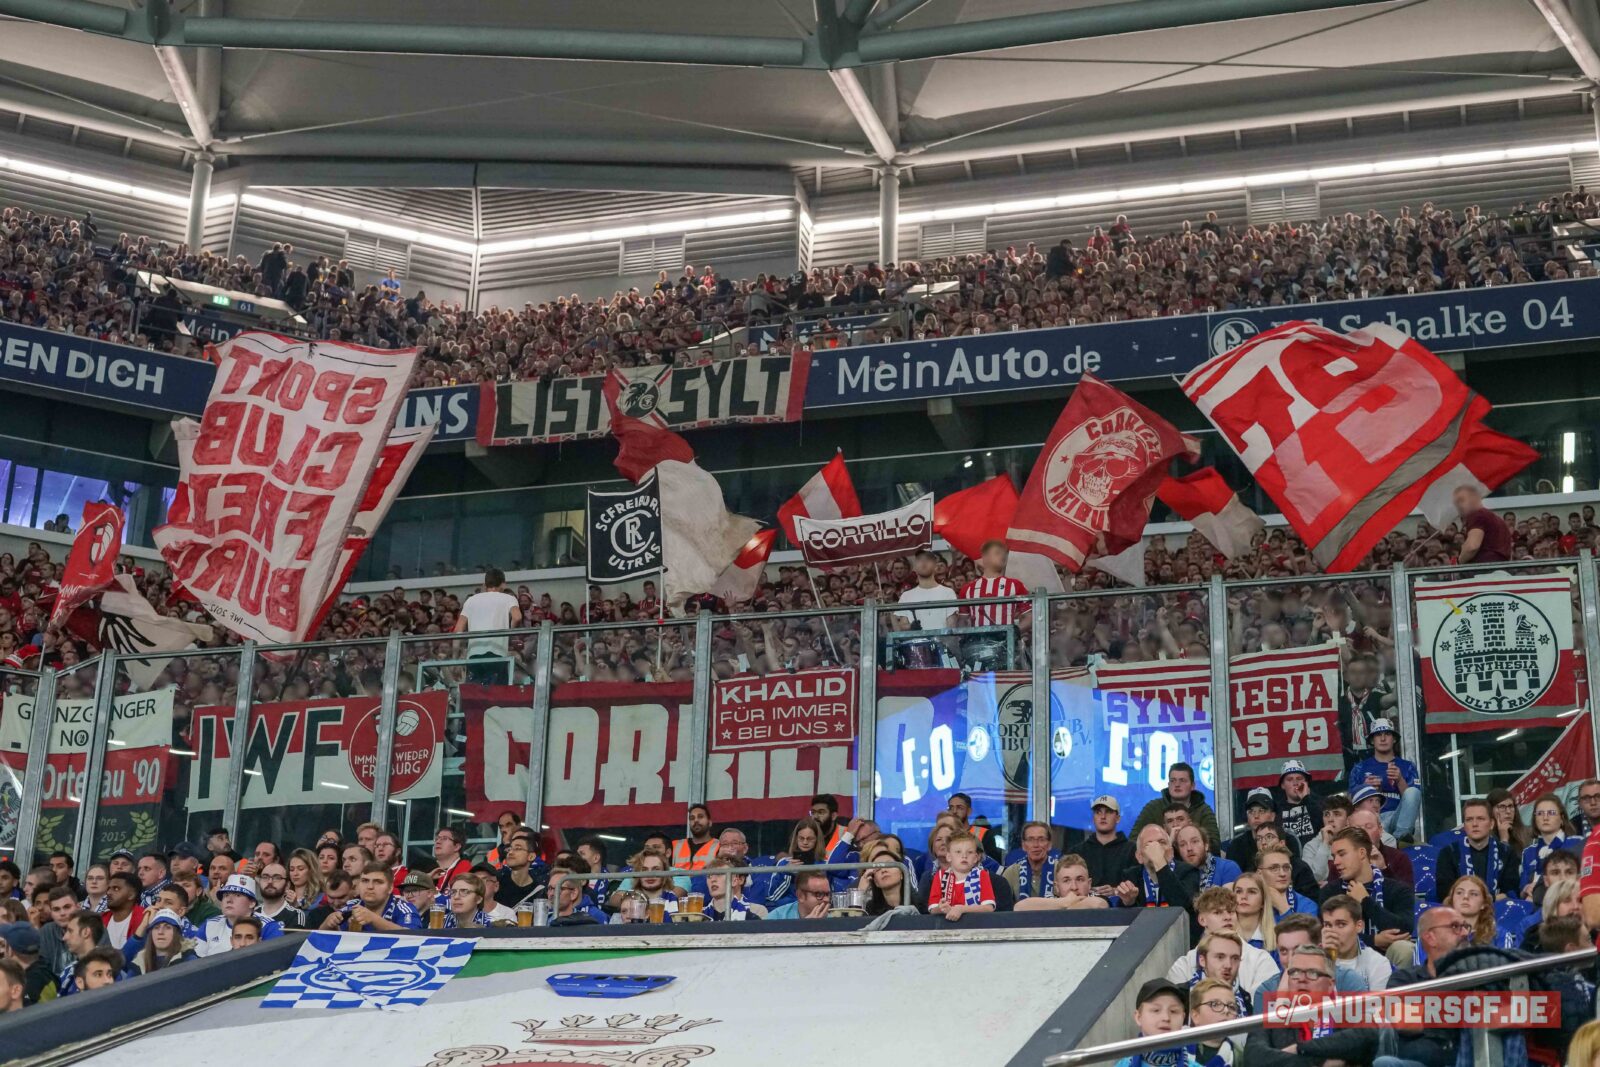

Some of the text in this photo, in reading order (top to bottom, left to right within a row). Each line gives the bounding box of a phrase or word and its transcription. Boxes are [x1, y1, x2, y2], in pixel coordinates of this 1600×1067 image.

[240, 303, 252, 312] 61
[1340, 296, 1574, 341] Shalke 04
[0, 338, 165, 394] EN DICH
[495, 357, 790, 437] LIST SYLT
[808, 513, 926, 550] CORRILLO
[608, 543, 660, 571] ULTRAS
[1455, 660, 1539, 674] SYNTHESIA
[721, 677, 847, 705] KHALID
[720, 703, 847, 725] FÜR IMMER
[738, 721, 828, 739] BEI UNS
[198, 706, 345, 799] IWF
[1283, 717, 1328, 753] 79
[396, 749, 429, 761] WIEDER
[902, 724, 955, 804] 1:0
[1102, 722, 1178, 793] 1:0
